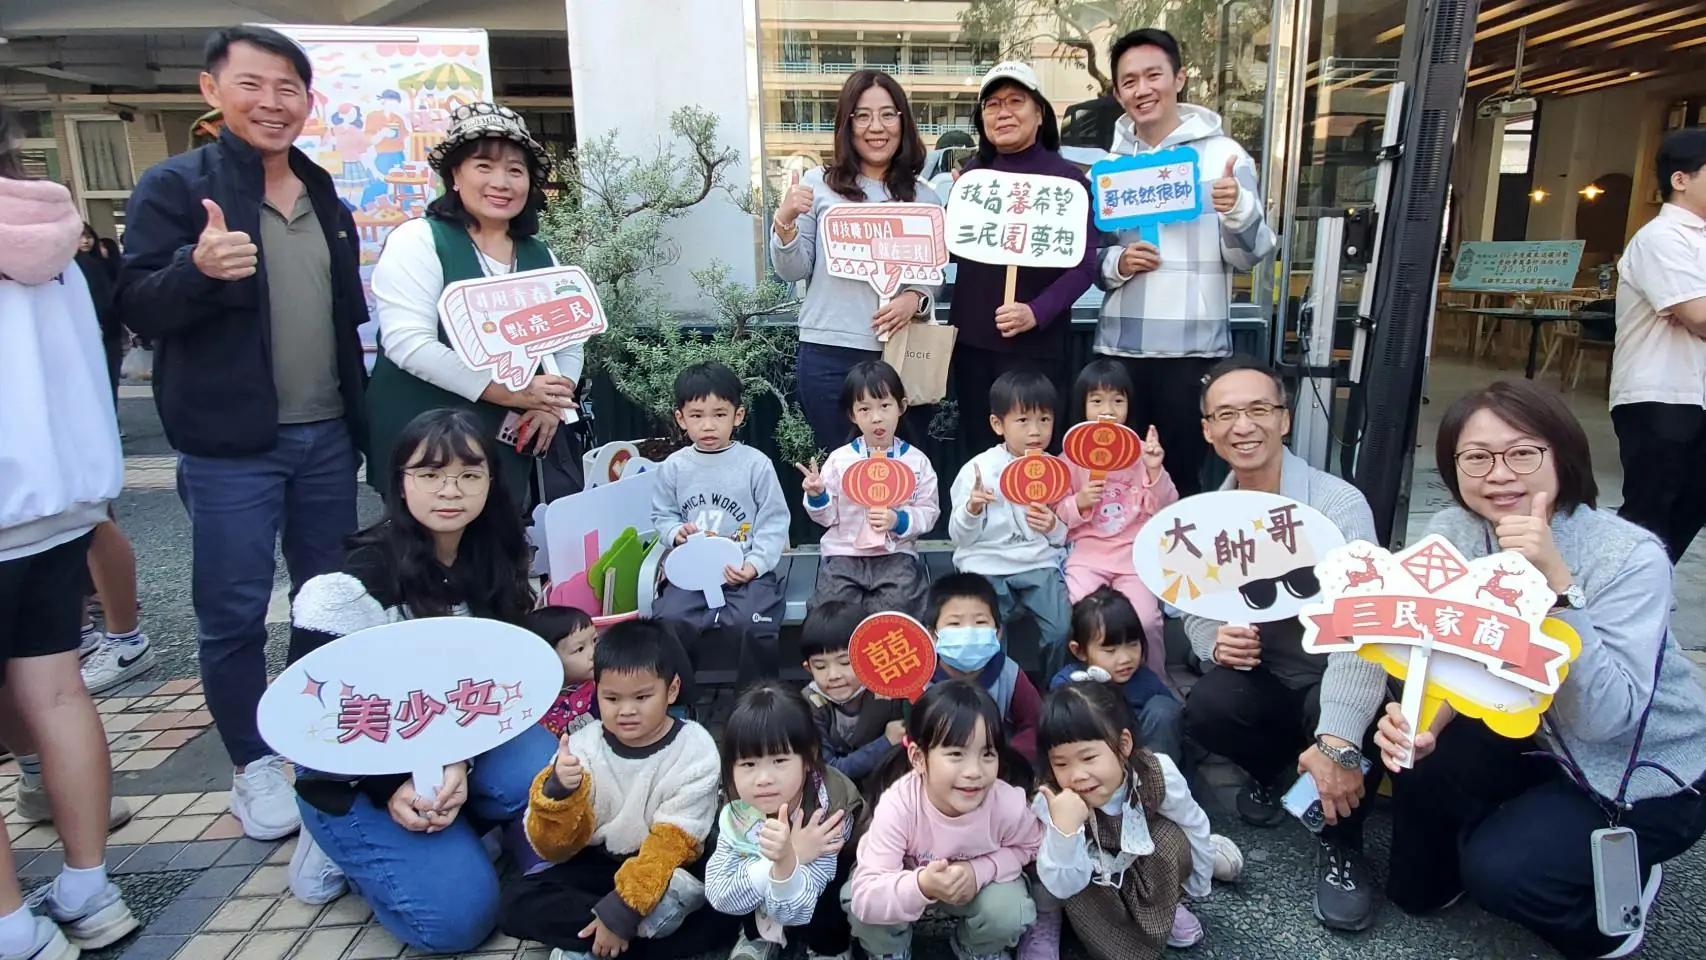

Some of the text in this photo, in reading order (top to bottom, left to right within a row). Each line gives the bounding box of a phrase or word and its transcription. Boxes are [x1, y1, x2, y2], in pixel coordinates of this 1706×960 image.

[960, 179, 1074, 216] 技高馨希望
[1103, 180, 1193, 208] 哥依然很帥
[955, 222, 1075, 258] 三民園夢想
[504, 301, 591, 340] 點亮三民
[711, 492, 747, 522] WORLD
[1164, 503, 1305, 577] 大帥哥
[1352, 600, 1511, 651] 三民家商
[336, 677, 503, 744] 美少女
